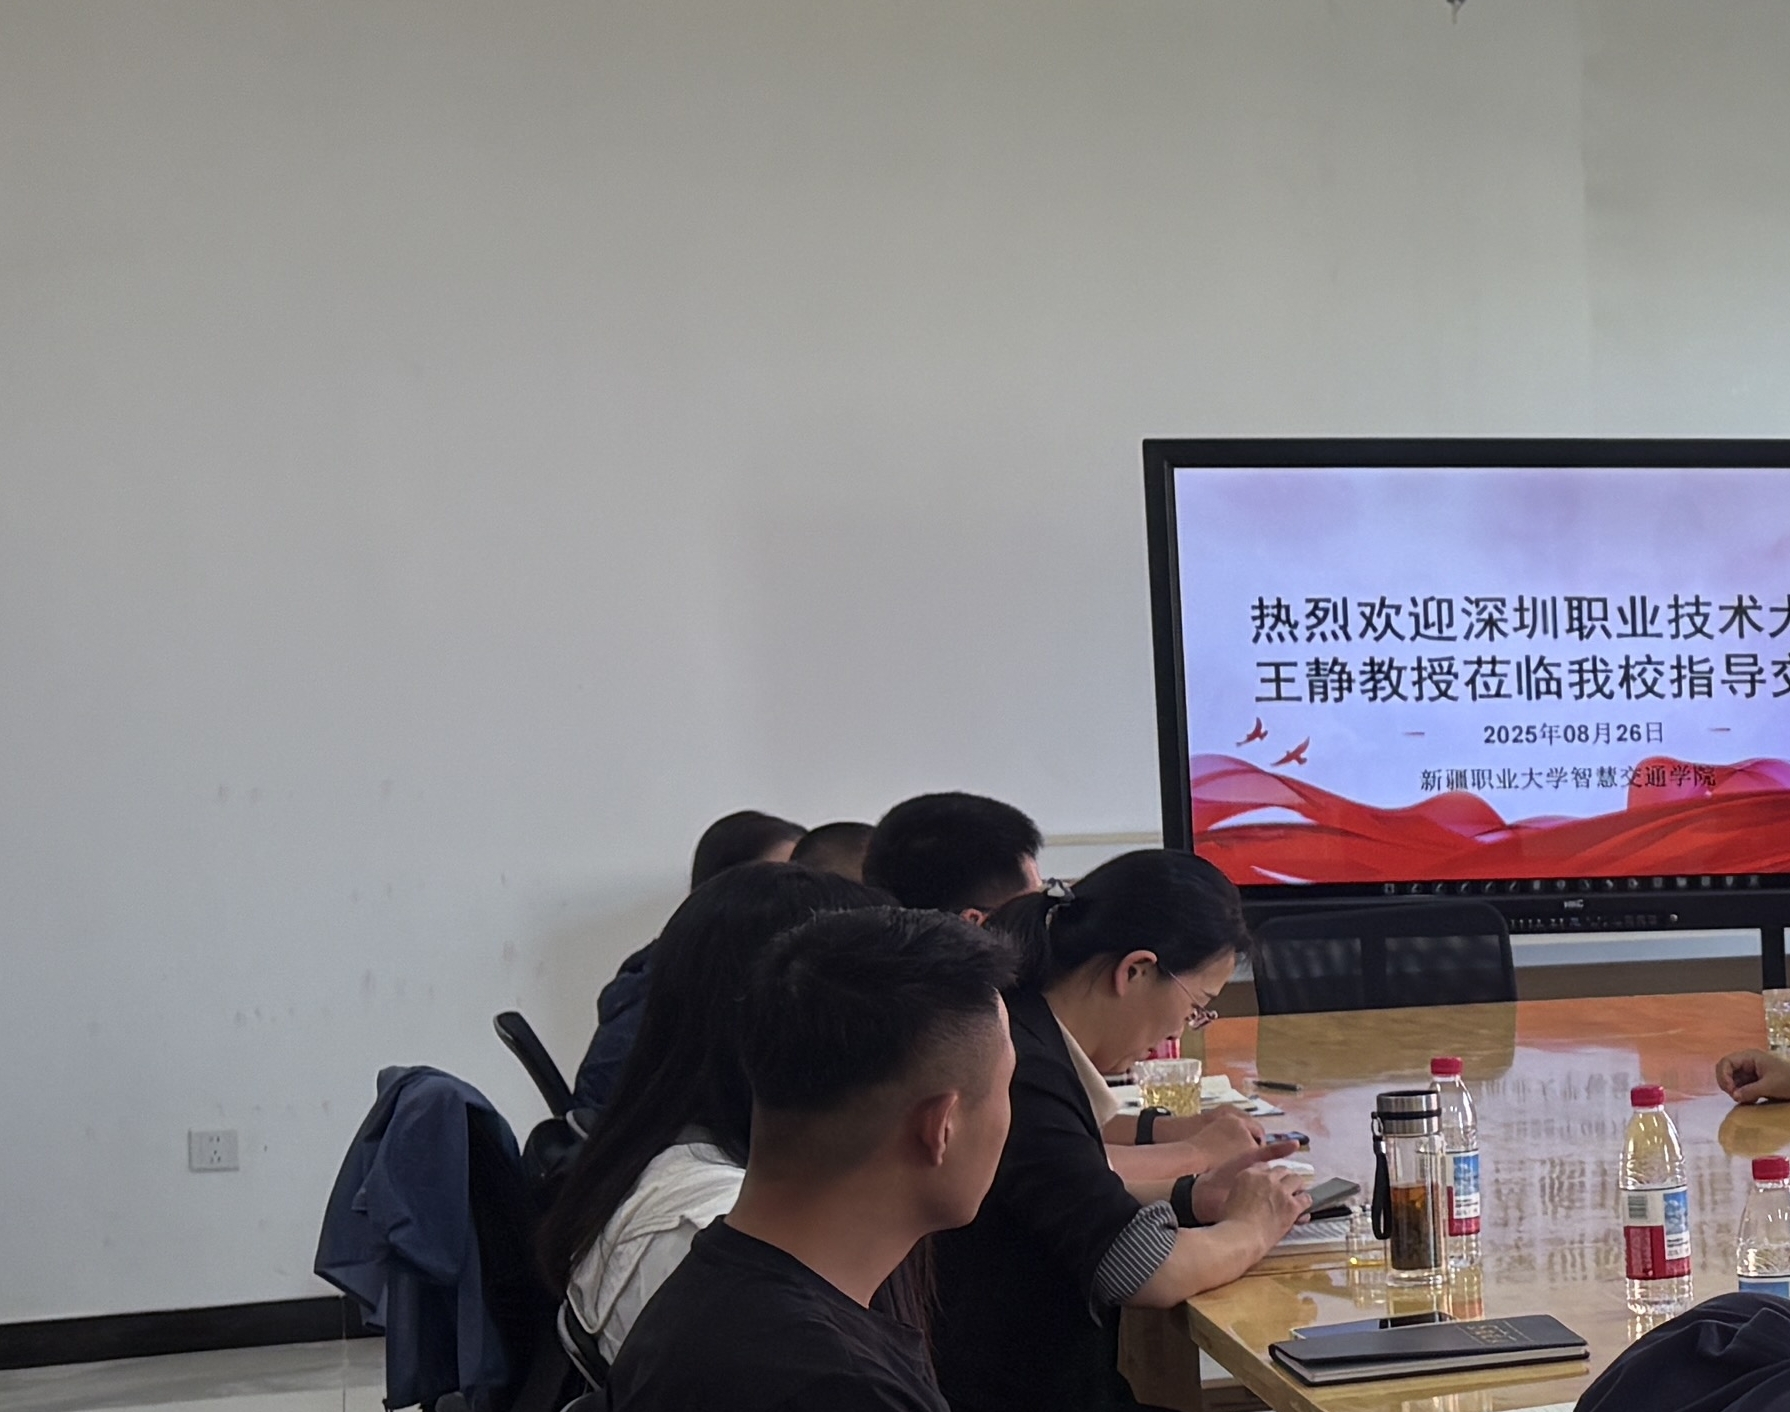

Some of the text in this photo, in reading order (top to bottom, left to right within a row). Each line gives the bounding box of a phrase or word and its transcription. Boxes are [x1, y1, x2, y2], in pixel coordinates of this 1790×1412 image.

[1483, 721, 1664, 746] 2025年08月26日
[1420, 765, 1717, 792] 新疆职业大学智慧交通学院
